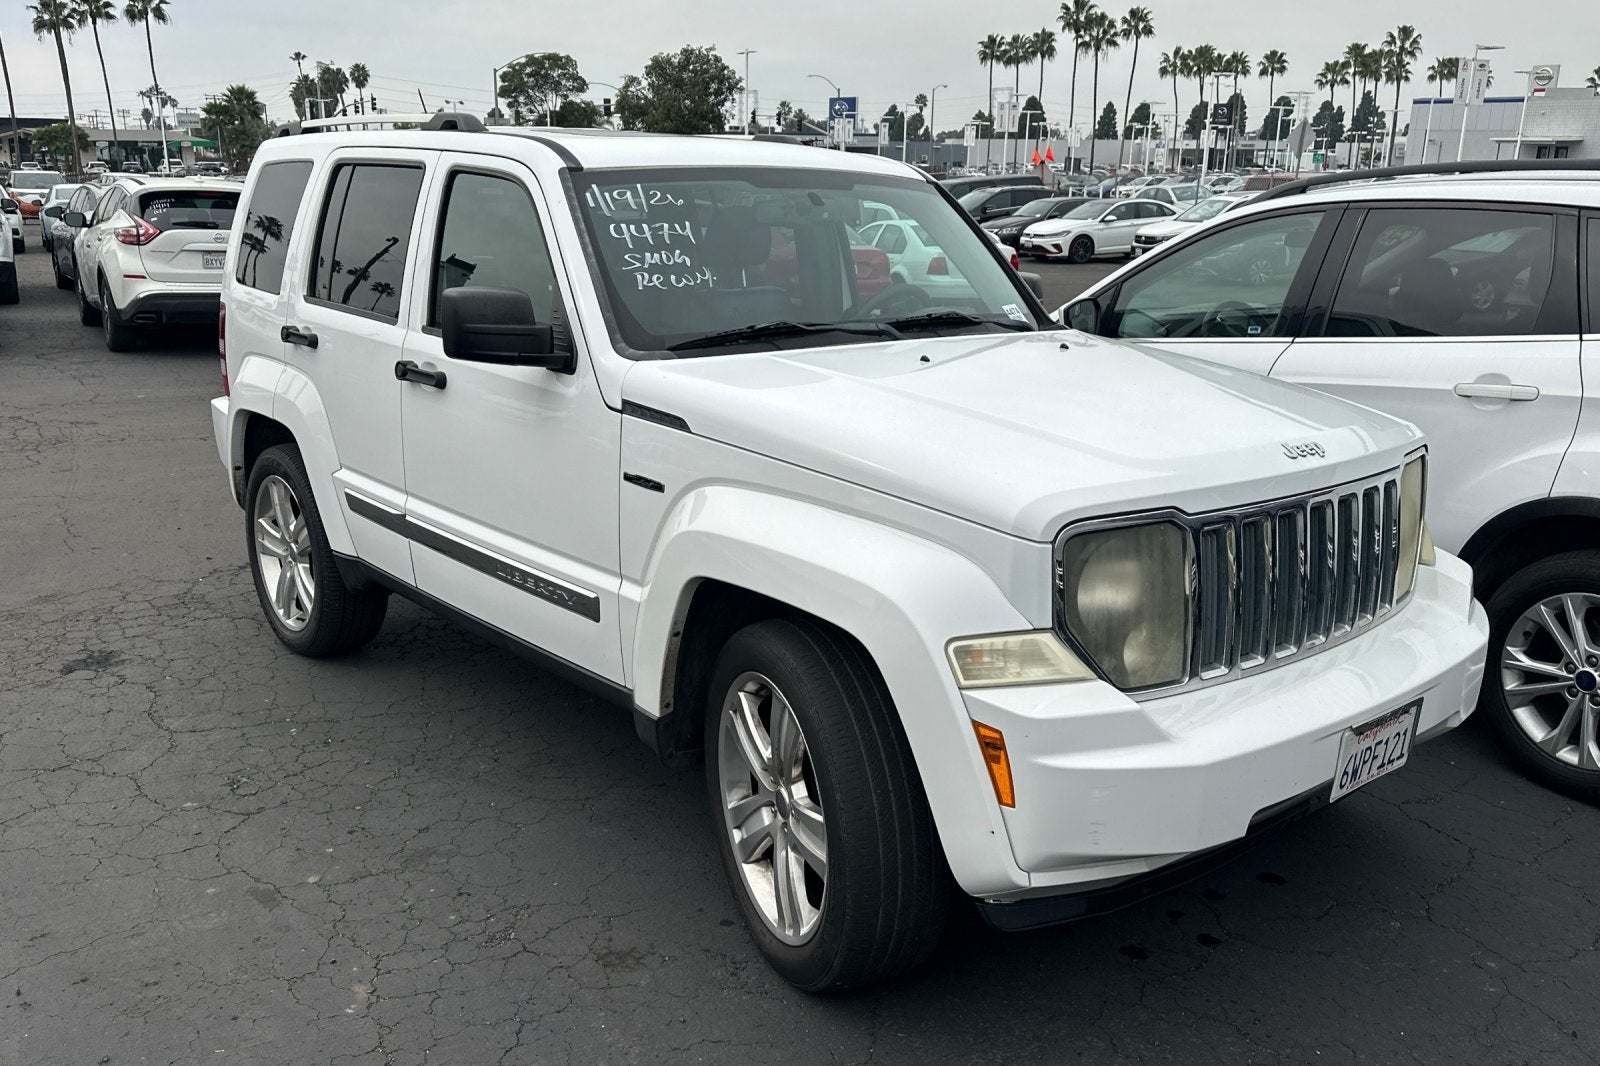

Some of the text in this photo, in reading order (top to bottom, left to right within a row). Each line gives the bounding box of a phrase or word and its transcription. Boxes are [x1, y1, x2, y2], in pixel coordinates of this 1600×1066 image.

[609, 220, 696, 249] 4474
[1280, 441, 1326, 460] Jeep
[495, 563, 577, 605] LIBERTY
[1339, 727, 1409, 789] 6WPF121
